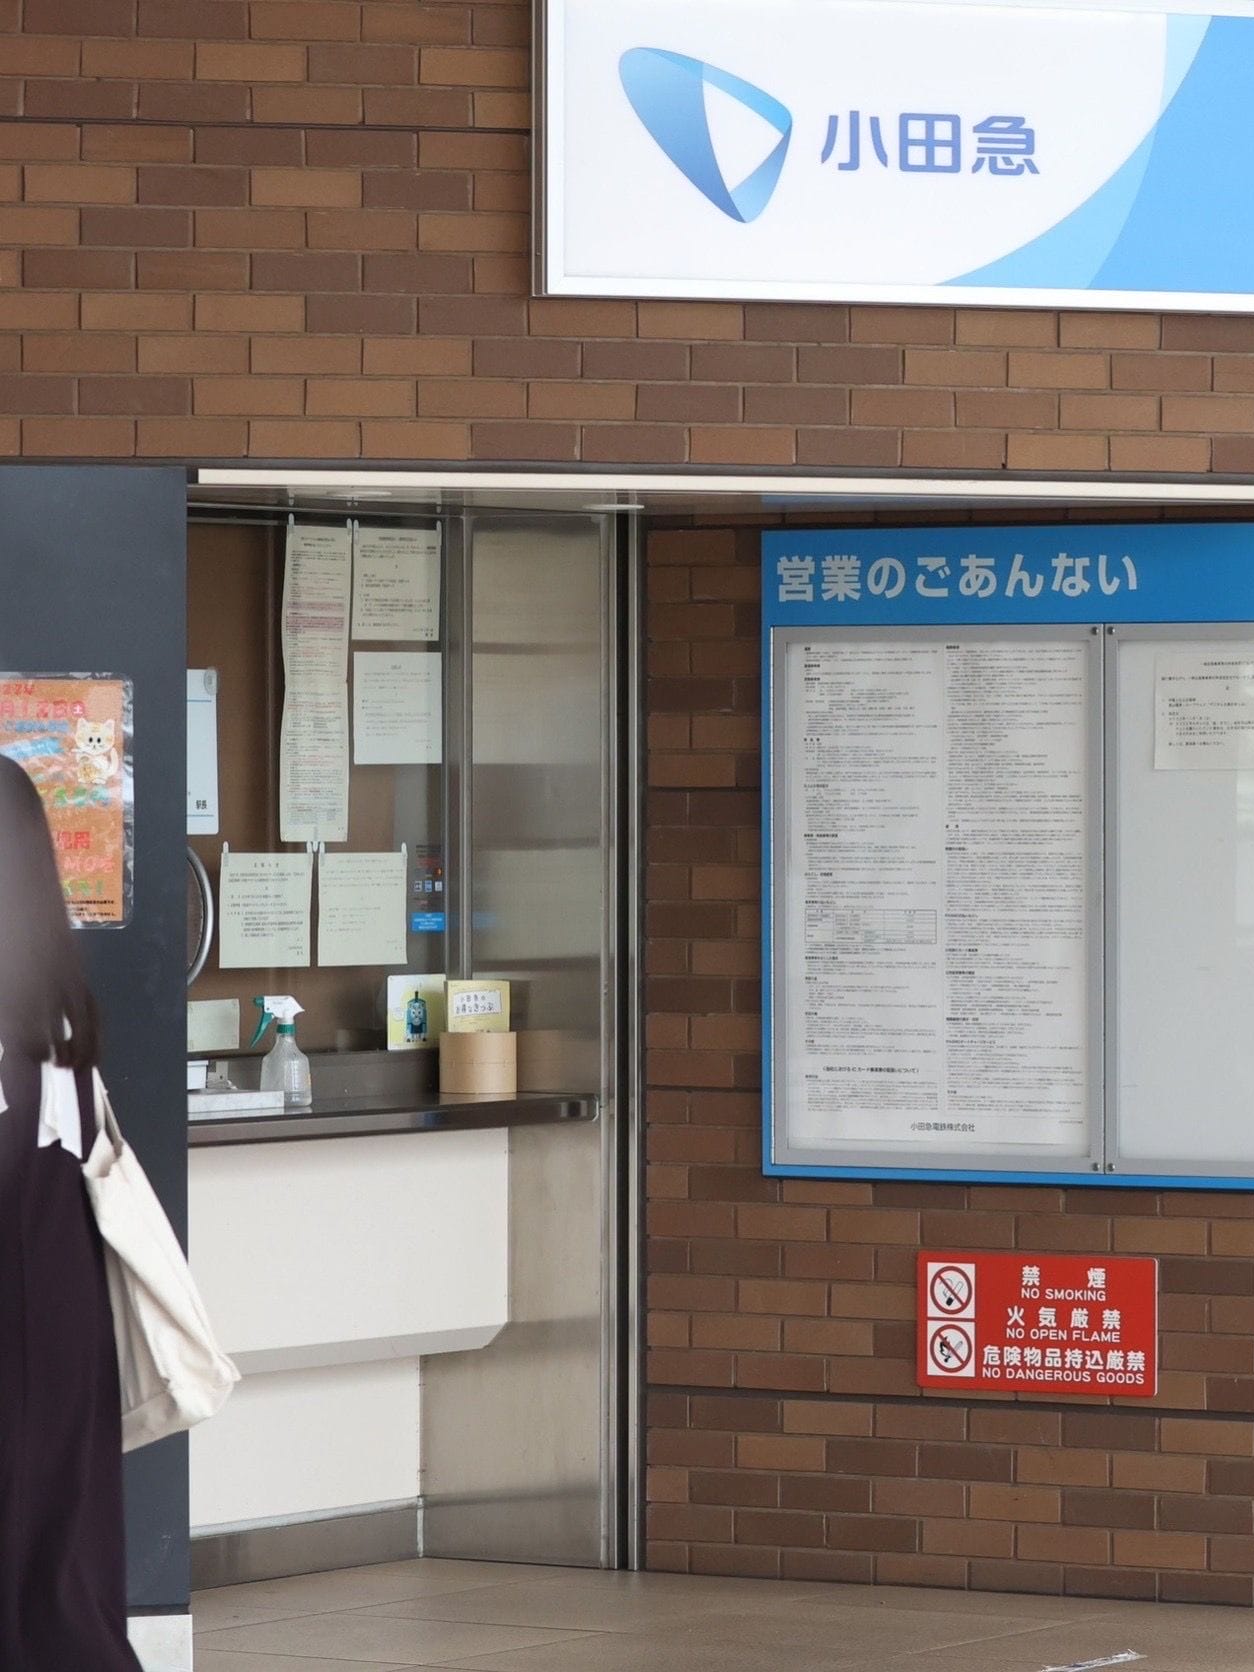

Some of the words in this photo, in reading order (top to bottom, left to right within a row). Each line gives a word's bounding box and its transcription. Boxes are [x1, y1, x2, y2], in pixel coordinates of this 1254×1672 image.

[820, 110, 1040, 176] 小田急
[776, 552, 1138, 602] 営業のごあんない
[910, 1121, 976, 1133] 小田急電鉄株式会社
[1021, 1265, 1107, 1289] 禁煙
[1021, 1288, 1040, 1299] NO
[1045, 1289, 1107, 1302] SMOKING
[1006, 1305, 1121, 1330] 火気厳禁
[1006, 1328, 1025, 1339] NO
[1030, 1329, 1068, 1341] OPEN
[1072, 1331, 1121, 1343] FLAME
[983, 1345, 1145, 1371] 危険物品持込厳禁
[982, 1367, 1001, 1379] NO
[1006, 1368, 1091, 1383] DANGEROUS
[1096, 1372, 1145, 1385] GOODS
